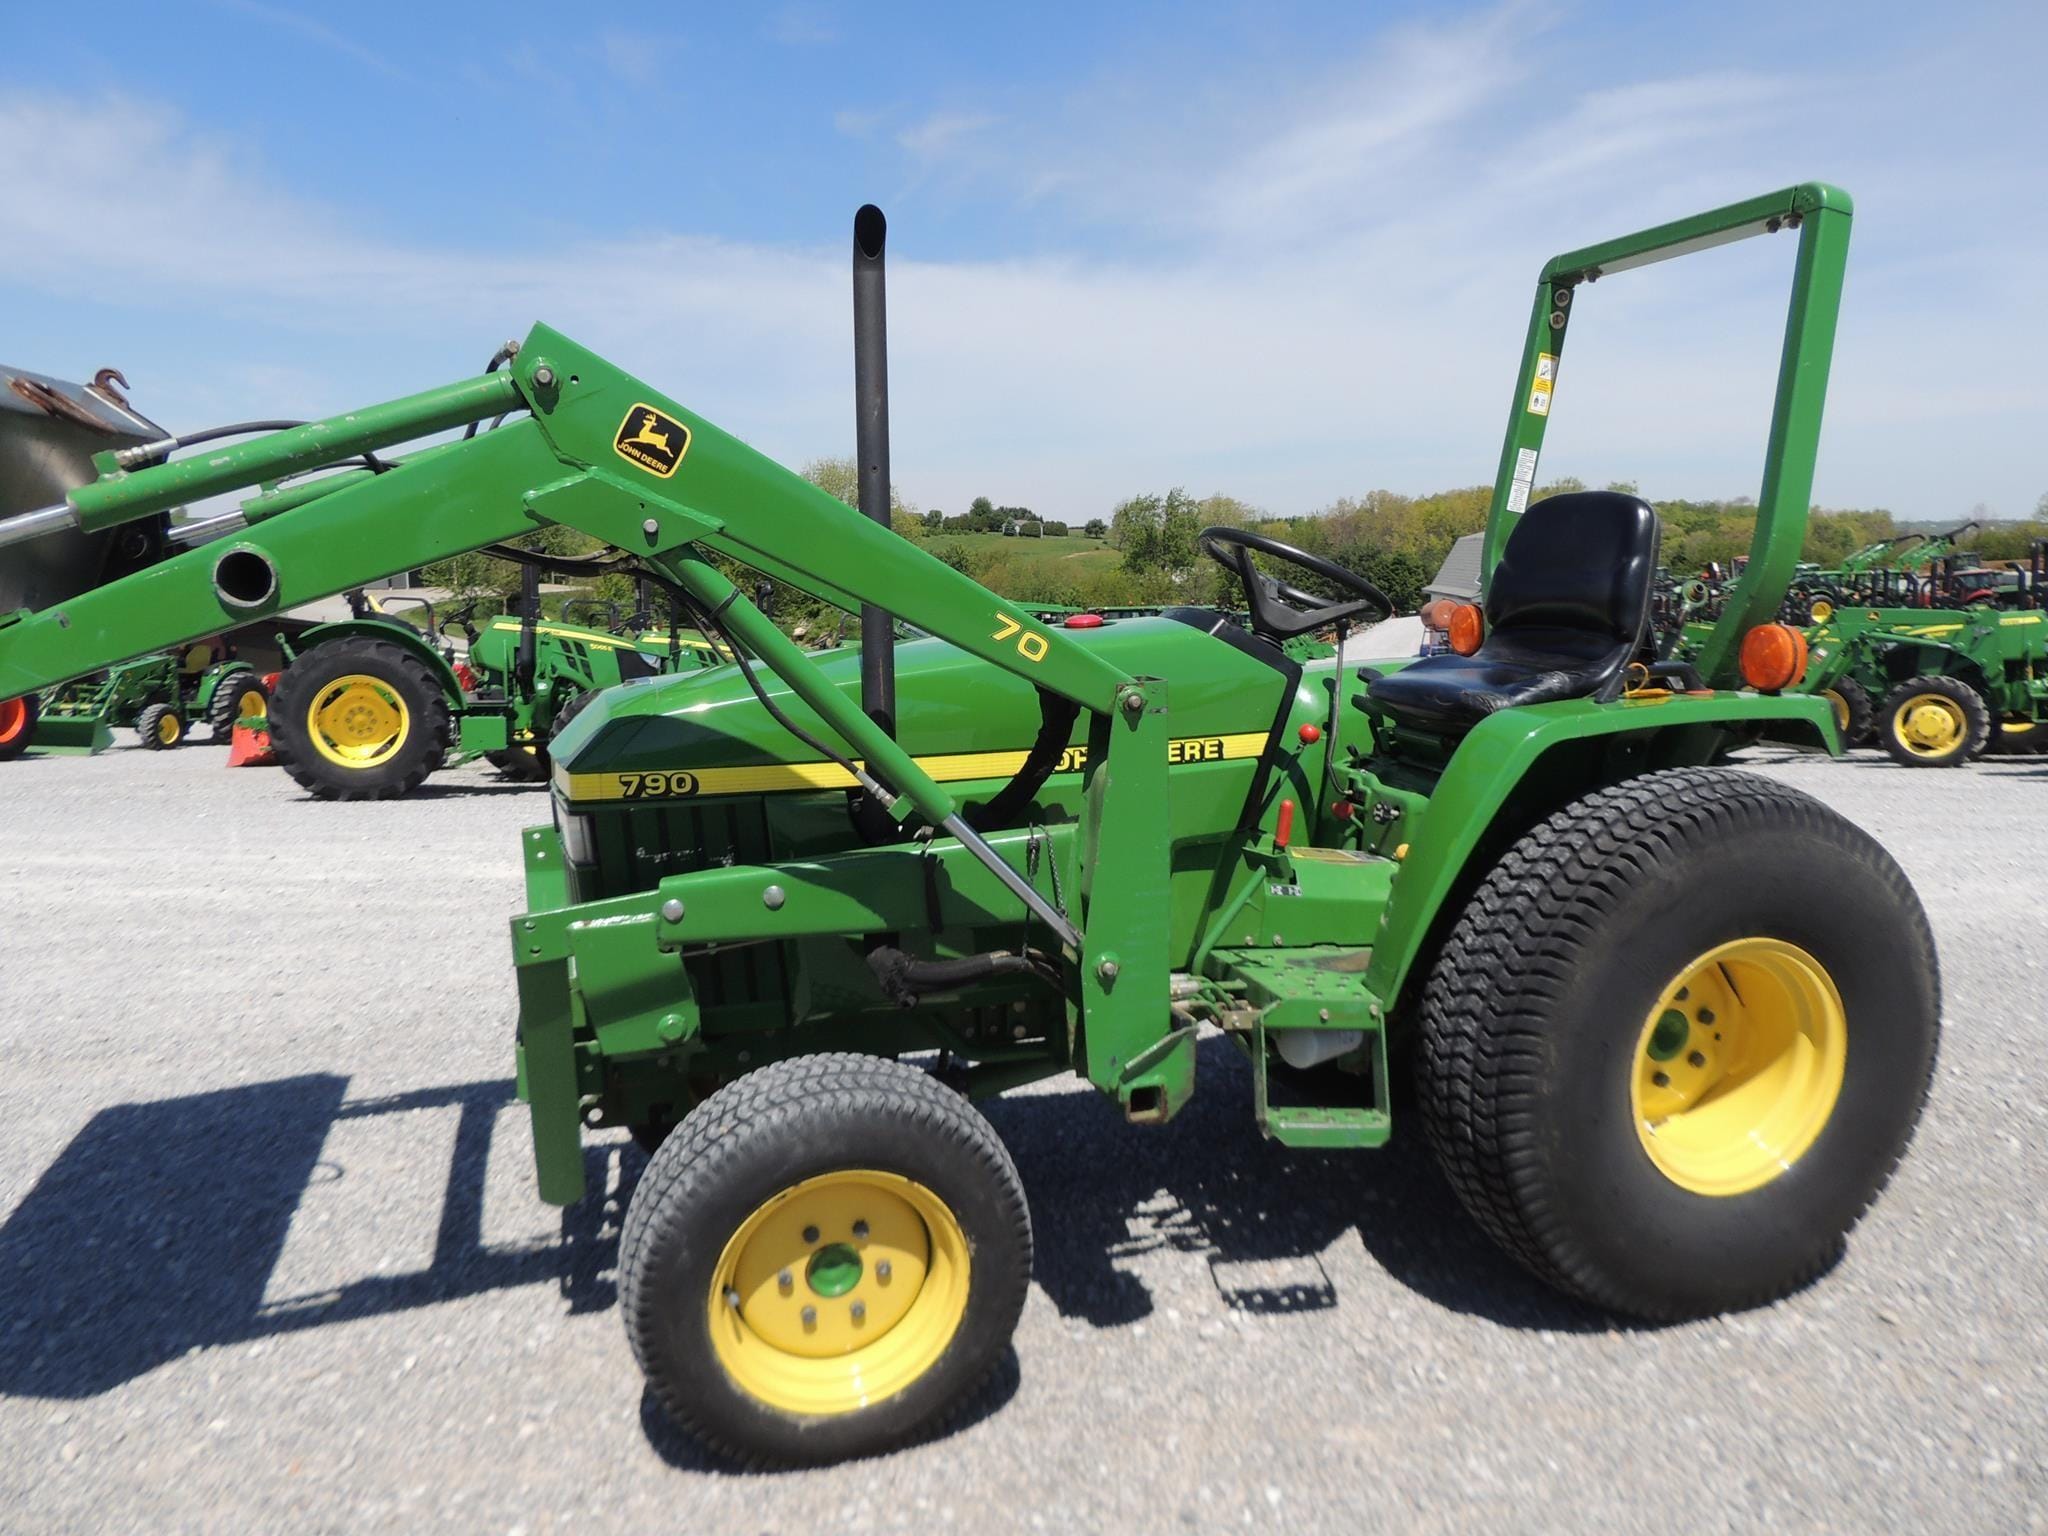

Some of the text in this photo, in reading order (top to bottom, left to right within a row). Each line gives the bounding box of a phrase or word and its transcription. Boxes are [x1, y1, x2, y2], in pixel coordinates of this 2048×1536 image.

[618, 442, 669, 473] JOHN DEERE
[991, 612, 1049, 662] 70
[1168, 740, 1222, 762] ERE
[620, 773, 698, 797] 790
